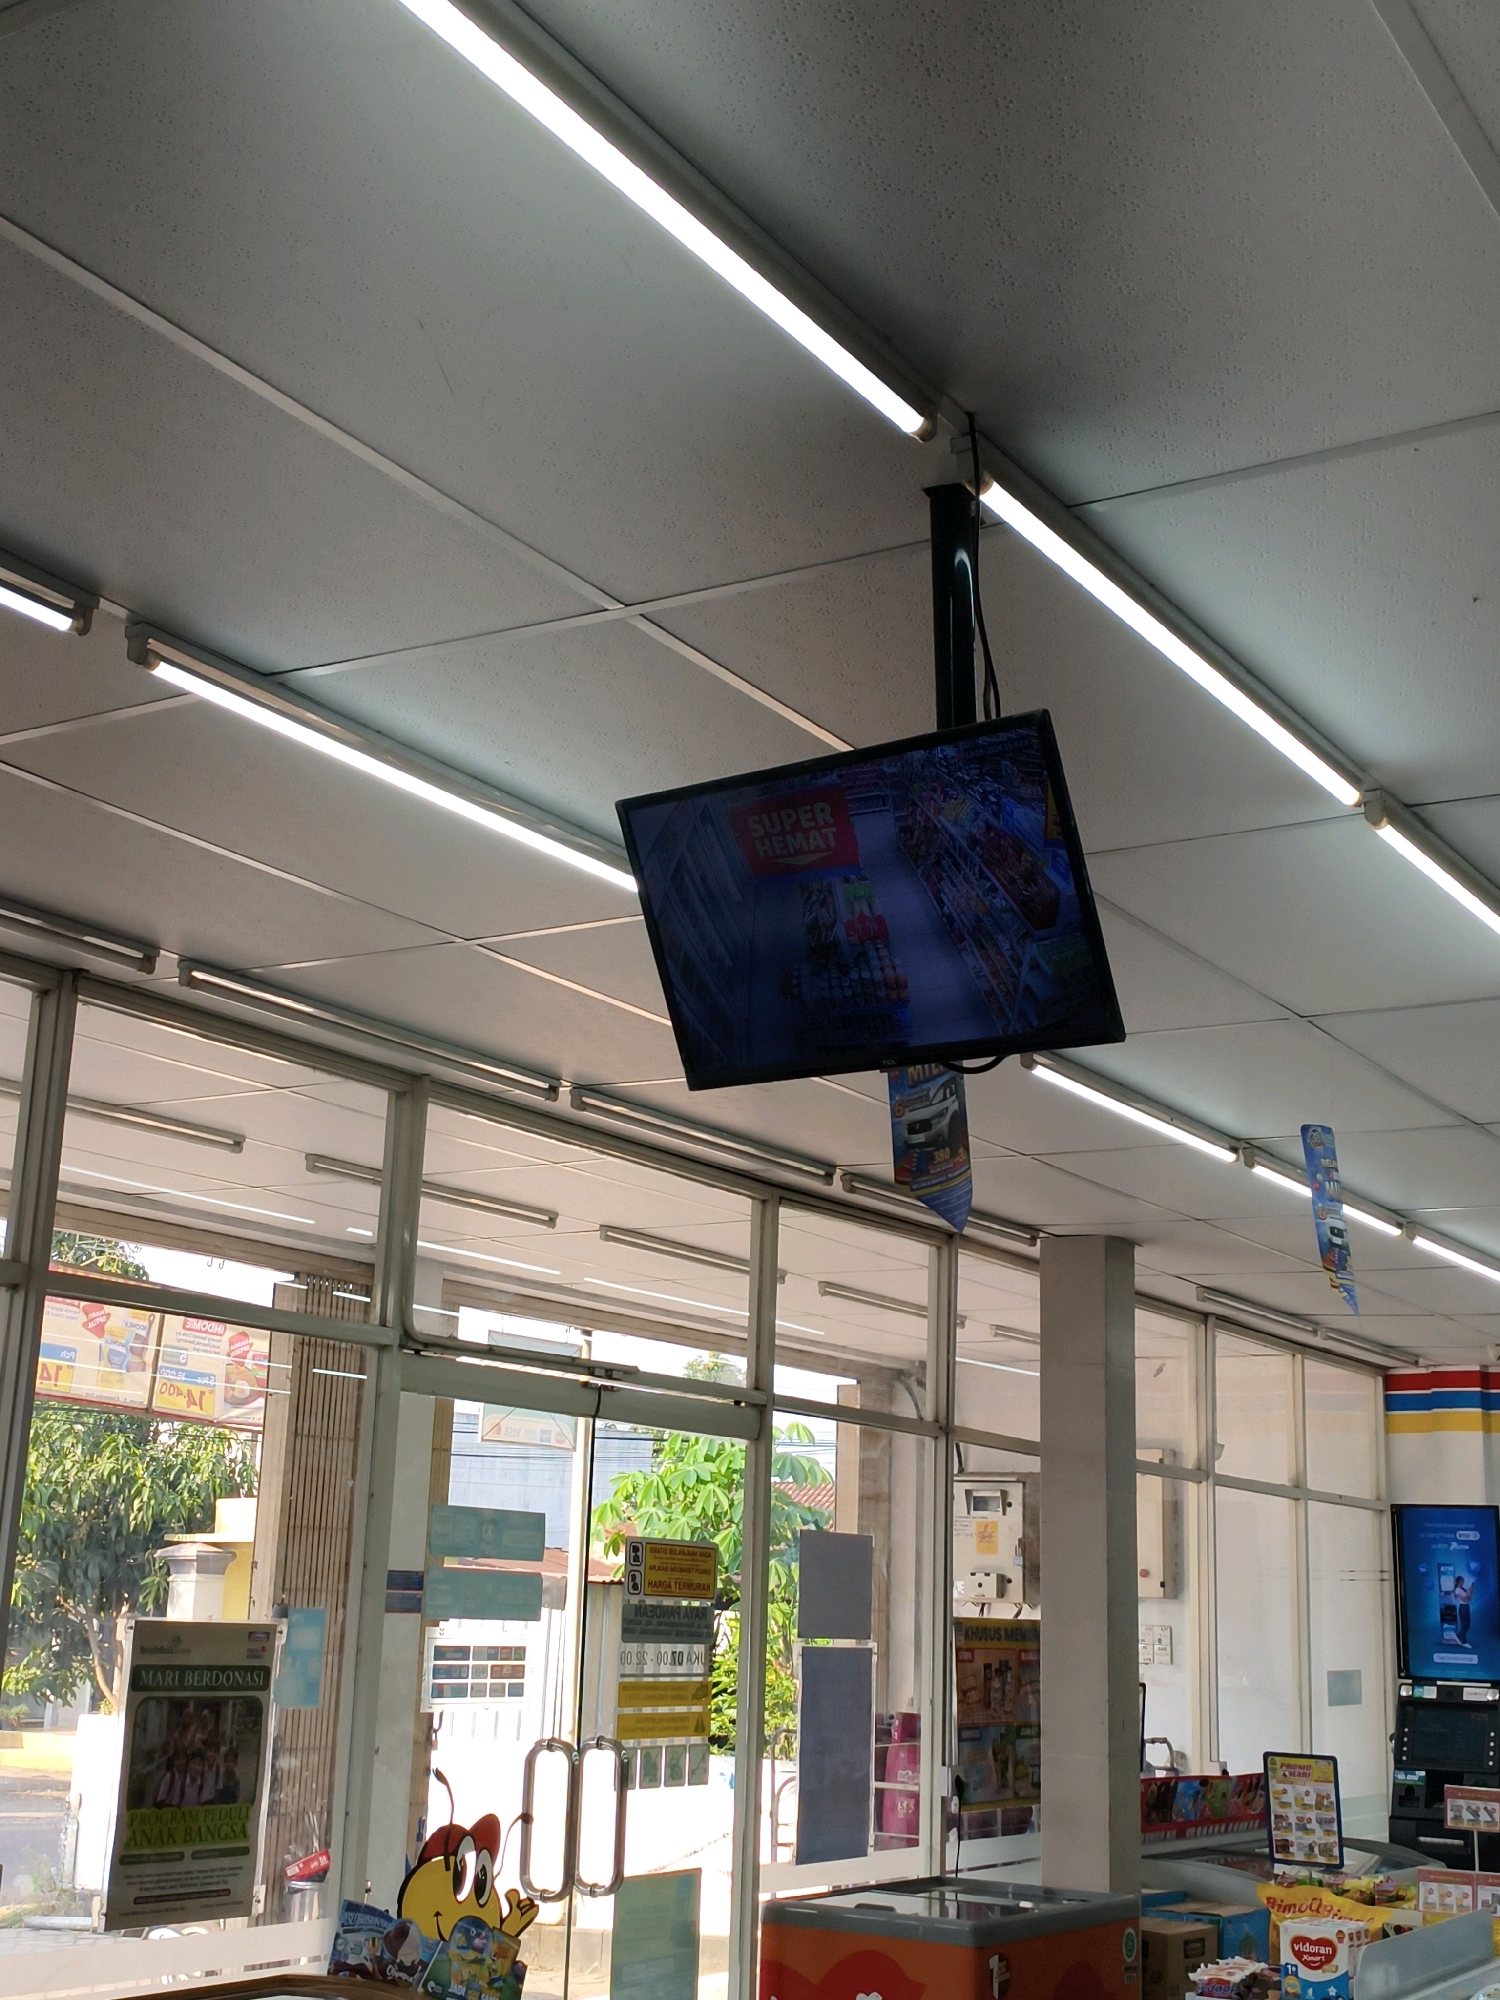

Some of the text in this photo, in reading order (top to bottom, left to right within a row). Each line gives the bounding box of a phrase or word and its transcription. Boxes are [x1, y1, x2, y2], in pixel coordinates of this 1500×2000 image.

[747, 802, 834, 837] SUPER
[754, 827, 837, 858] HEMAT
[933, 1147, 951, 1164] 380
[648, 1579, 711, 1593] HARGA TERMURAH
[964, 1626, 1003, 1642] KHUSUS
[140, 1669, 265, 1687] MARI BERDONASI
[1280, 1762, 1312, 1771] PROMO
[128, 1805, 251, 1827] PROGRAM PEDULI
[126, 1822, 248, 1847] ANAK BANGSA
[1293, 1942, 1333, 1955] vidoran
